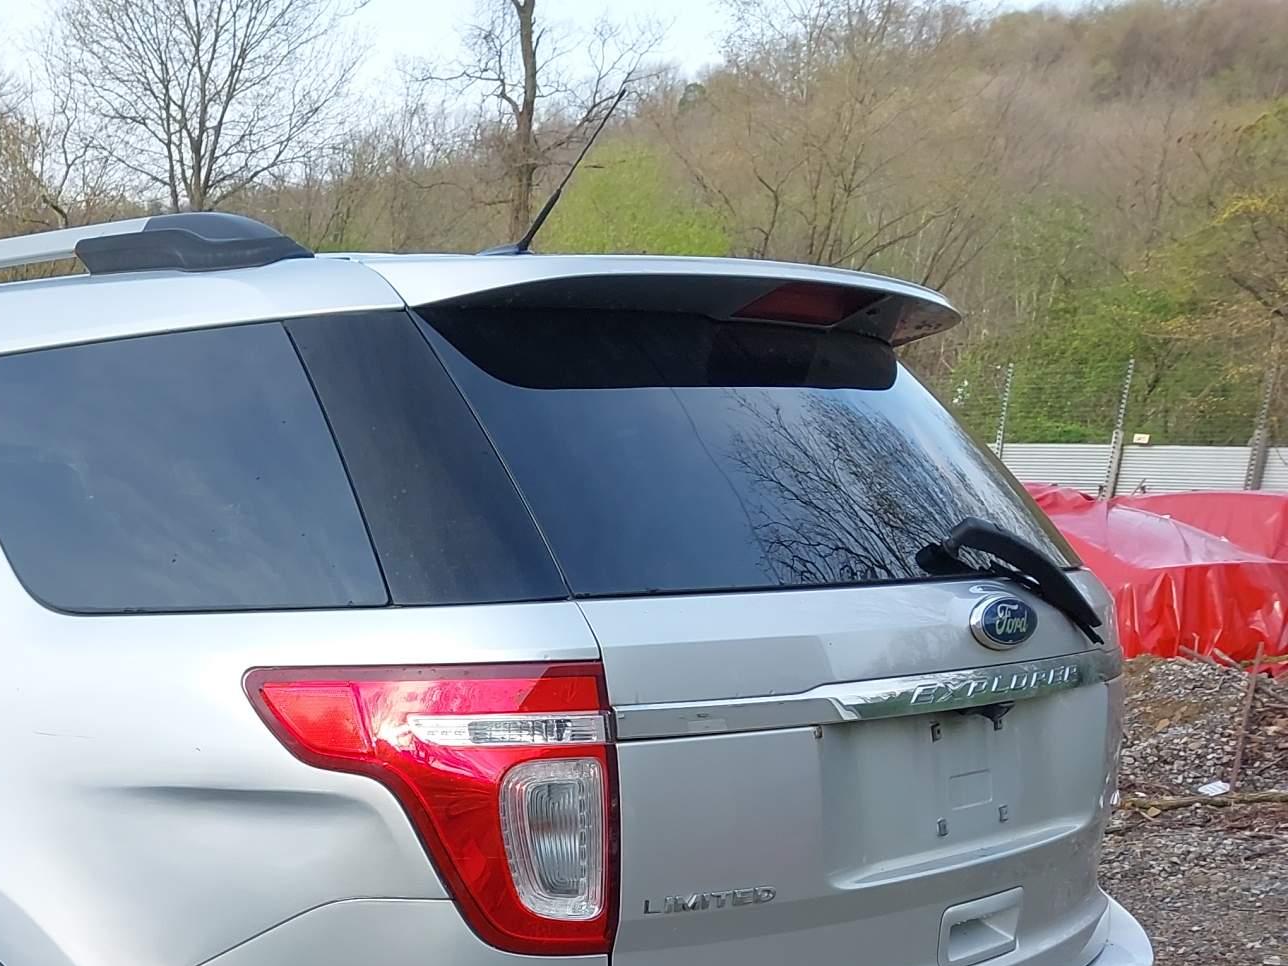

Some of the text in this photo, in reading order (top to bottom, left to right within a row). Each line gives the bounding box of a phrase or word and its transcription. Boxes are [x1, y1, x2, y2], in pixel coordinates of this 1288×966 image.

[994, 602, 1028, 635] Ford
[910, 664, 1080, 705] EXPLORER
[643, 884, 777, 914] LIMITED
